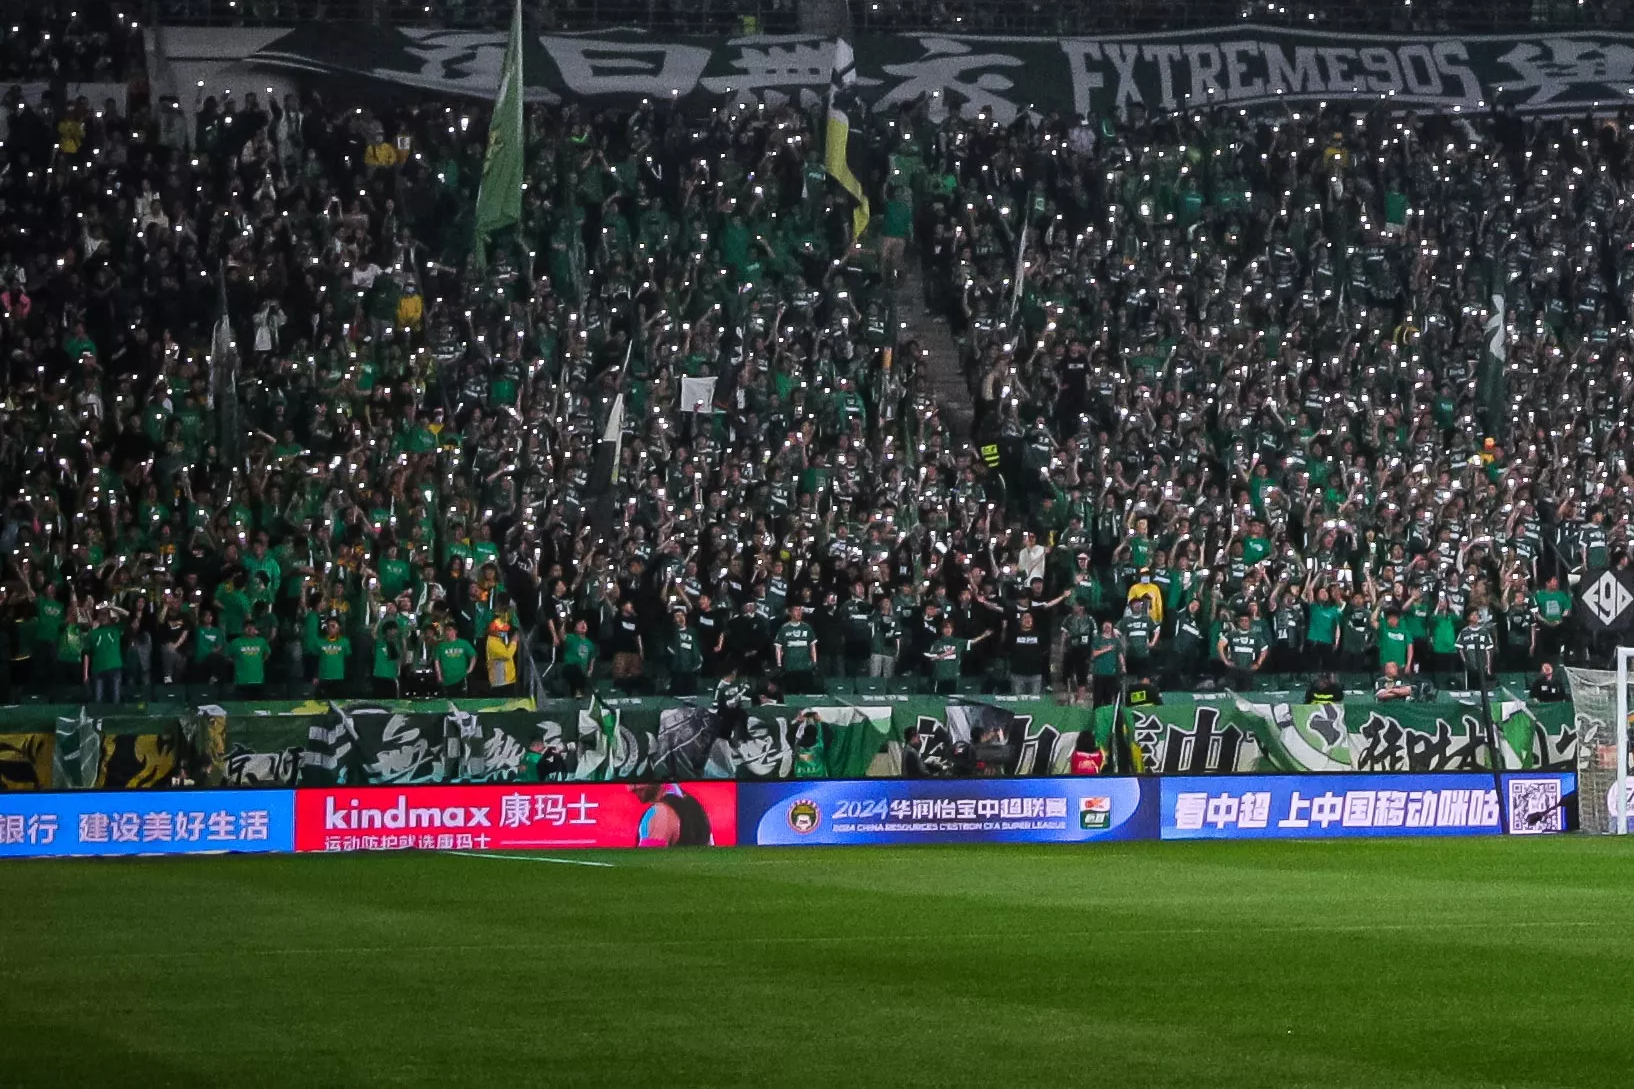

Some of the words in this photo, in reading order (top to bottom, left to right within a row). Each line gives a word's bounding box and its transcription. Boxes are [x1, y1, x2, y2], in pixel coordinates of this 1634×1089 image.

[0, 813, 58, 845] 银行
[79, 810, 269, 843] 建设美好生活
[324, 795, 491, 829] kindmax
[499, 792, 599, 828] 康玛士
[1176, 791, 1271, 830] 看中超
[1278, 789, 1500, 828] 上中国移动咪咕
